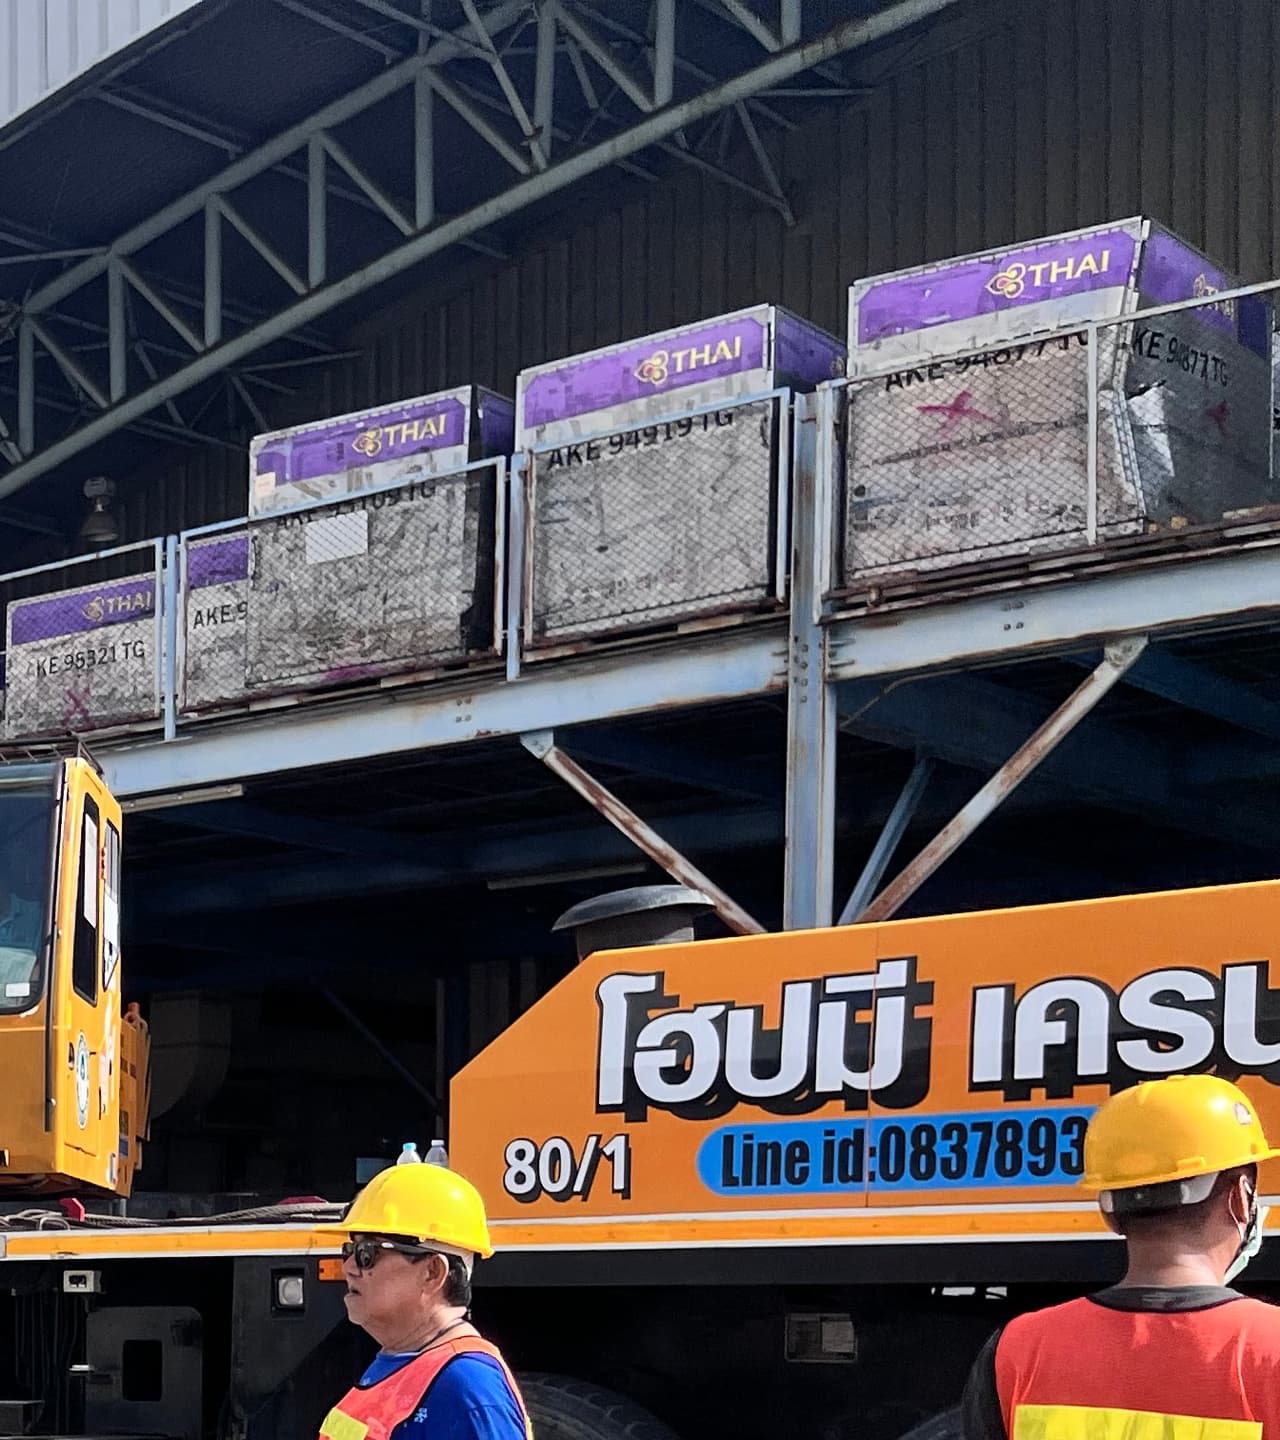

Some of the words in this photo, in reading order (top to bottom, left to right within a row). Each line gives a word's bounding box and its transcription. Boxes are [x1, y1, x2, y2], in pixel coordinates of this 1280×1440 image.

[1028, 250, 1110, 287] THAI
[672, 335, 741, 373] THAI
[385, 413, 446, 447] THAI
[547, 442, 602, 471] AKE
[106, 591, 152, 615] THAI
[193, 604, 231, 629] AKE
[122, 640, 145, 660] TG
[503, 1133, 630, 1200] 80/1
[721, 1132, 811, 1188] Line
